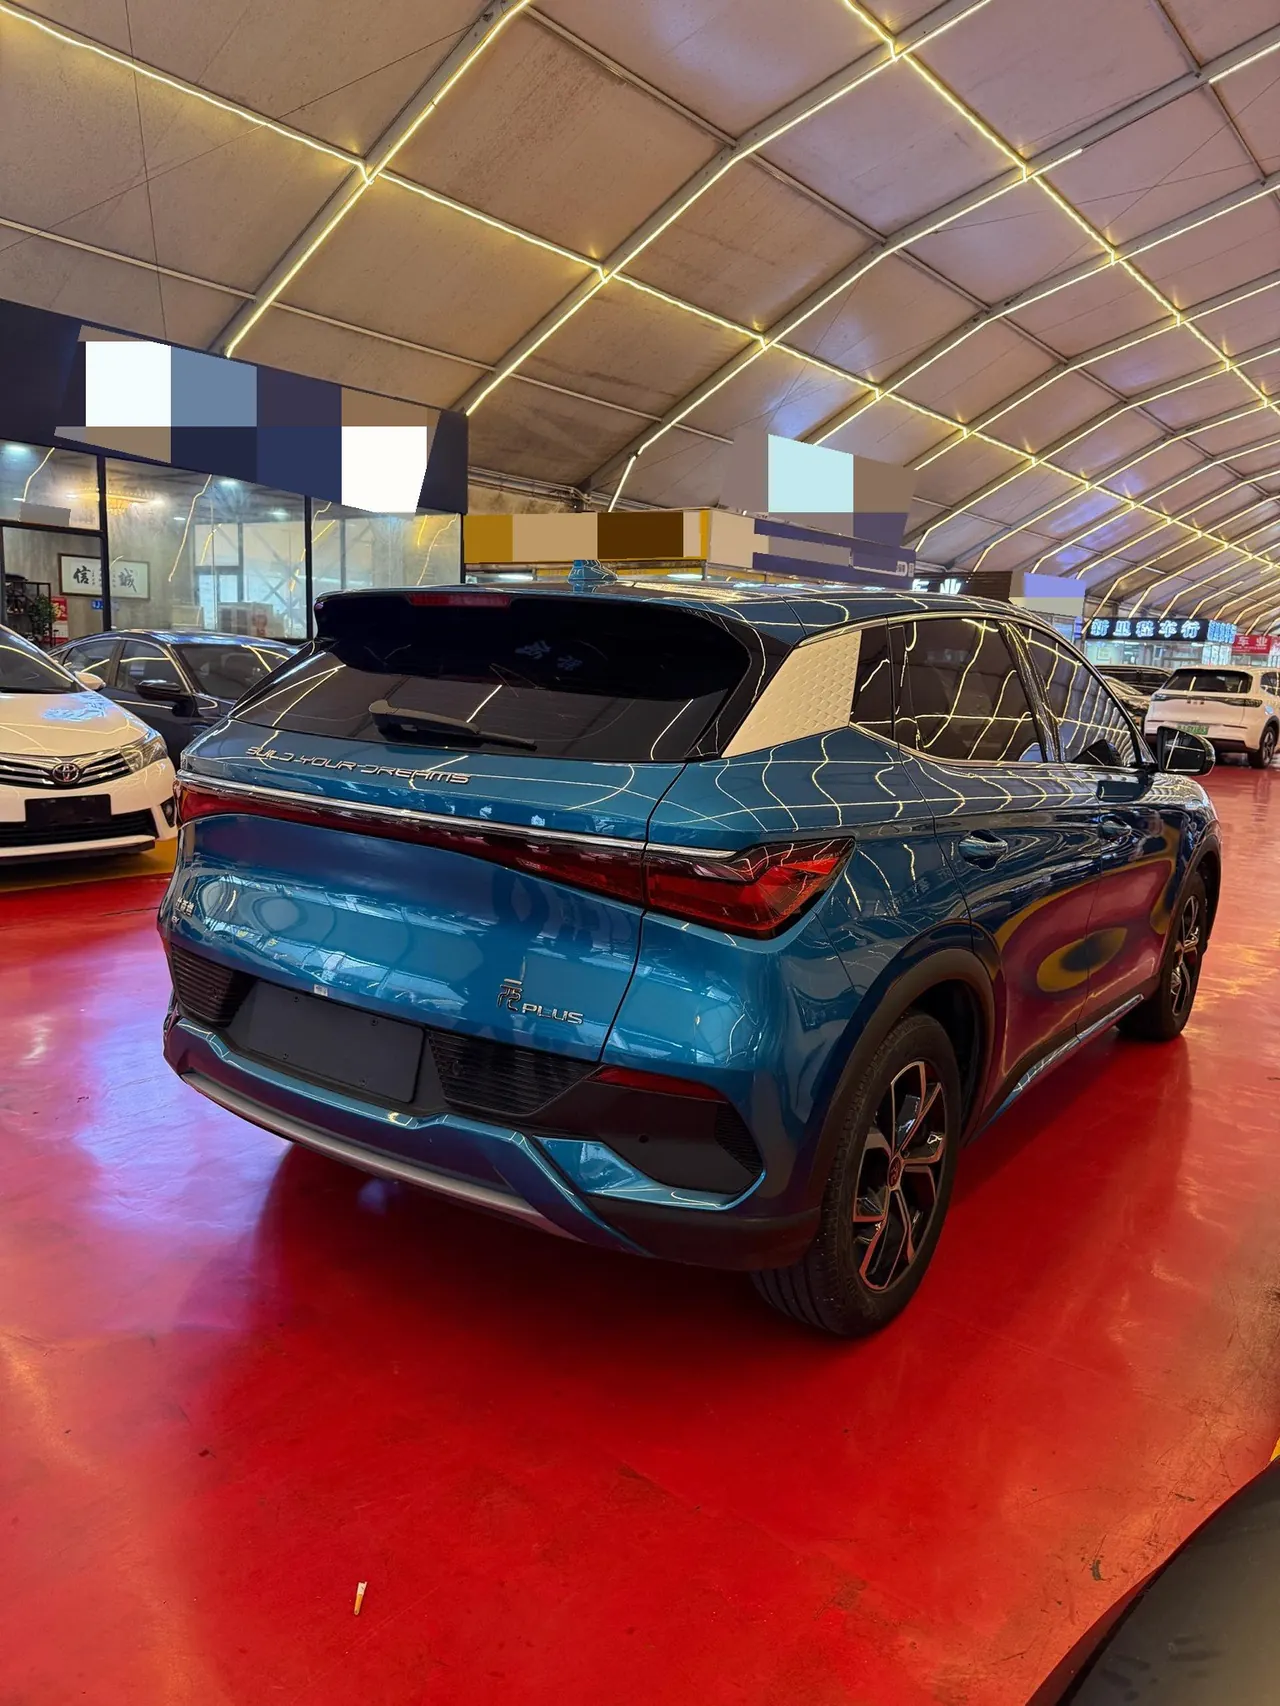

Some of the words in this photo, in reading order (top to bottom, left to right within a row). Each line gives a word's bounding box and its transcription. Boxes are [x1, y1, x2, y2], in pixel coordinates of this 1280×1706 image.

[245, 746, 295, 763] BUILD
[300, 754, 357, 771] YOUR
[360, 764, 471, 785] DREAMS
[522, 1003, 584, 1025] PLUS
